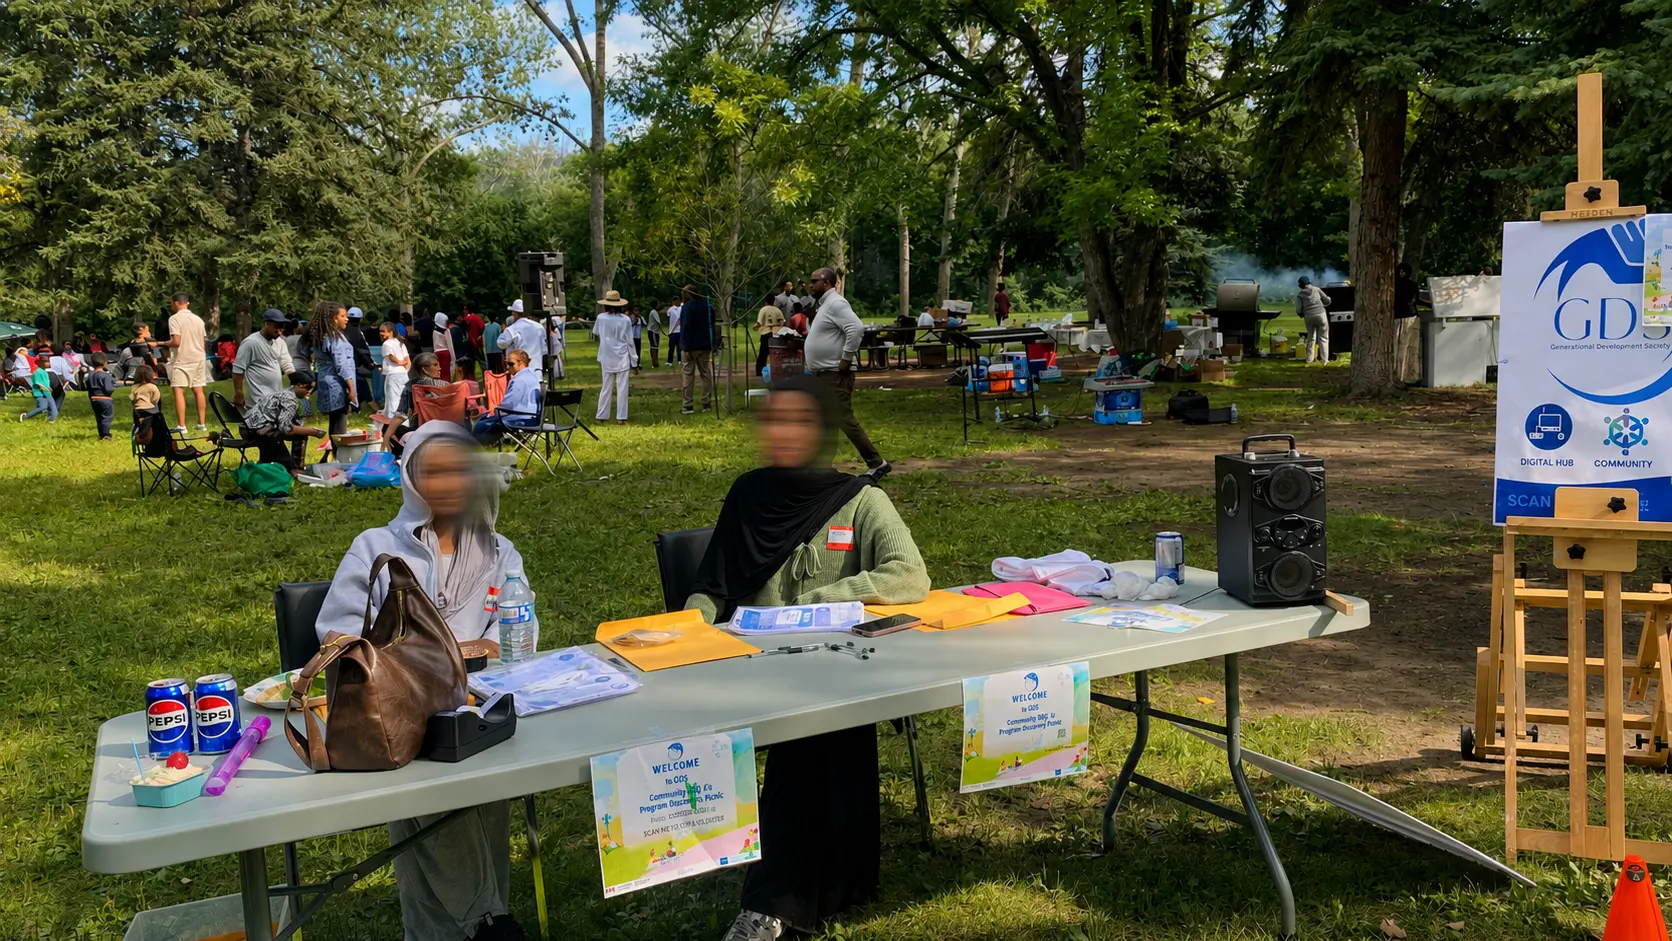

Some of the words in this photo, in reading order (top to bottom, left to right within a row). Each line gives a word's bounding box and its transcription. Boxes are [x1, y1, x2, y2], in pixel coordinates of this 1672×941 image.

[1596, 343, 1643, 351] Development
[1644, 342, 1671, 350] Society
[1520, 458, 1553, 467] DIGITAL
[1555, 459, 1574, 467] HUB
[1594, 459, 1653, 469] COMMUNITY
[1507, 494, 1551, 508] SCAN
[148, 713, 186, 726] PEPSI
[652, 758, 700, 774] WELCOME
[639, 803, 668, 814] Program
[643, 828, 661, 838] SCAN
